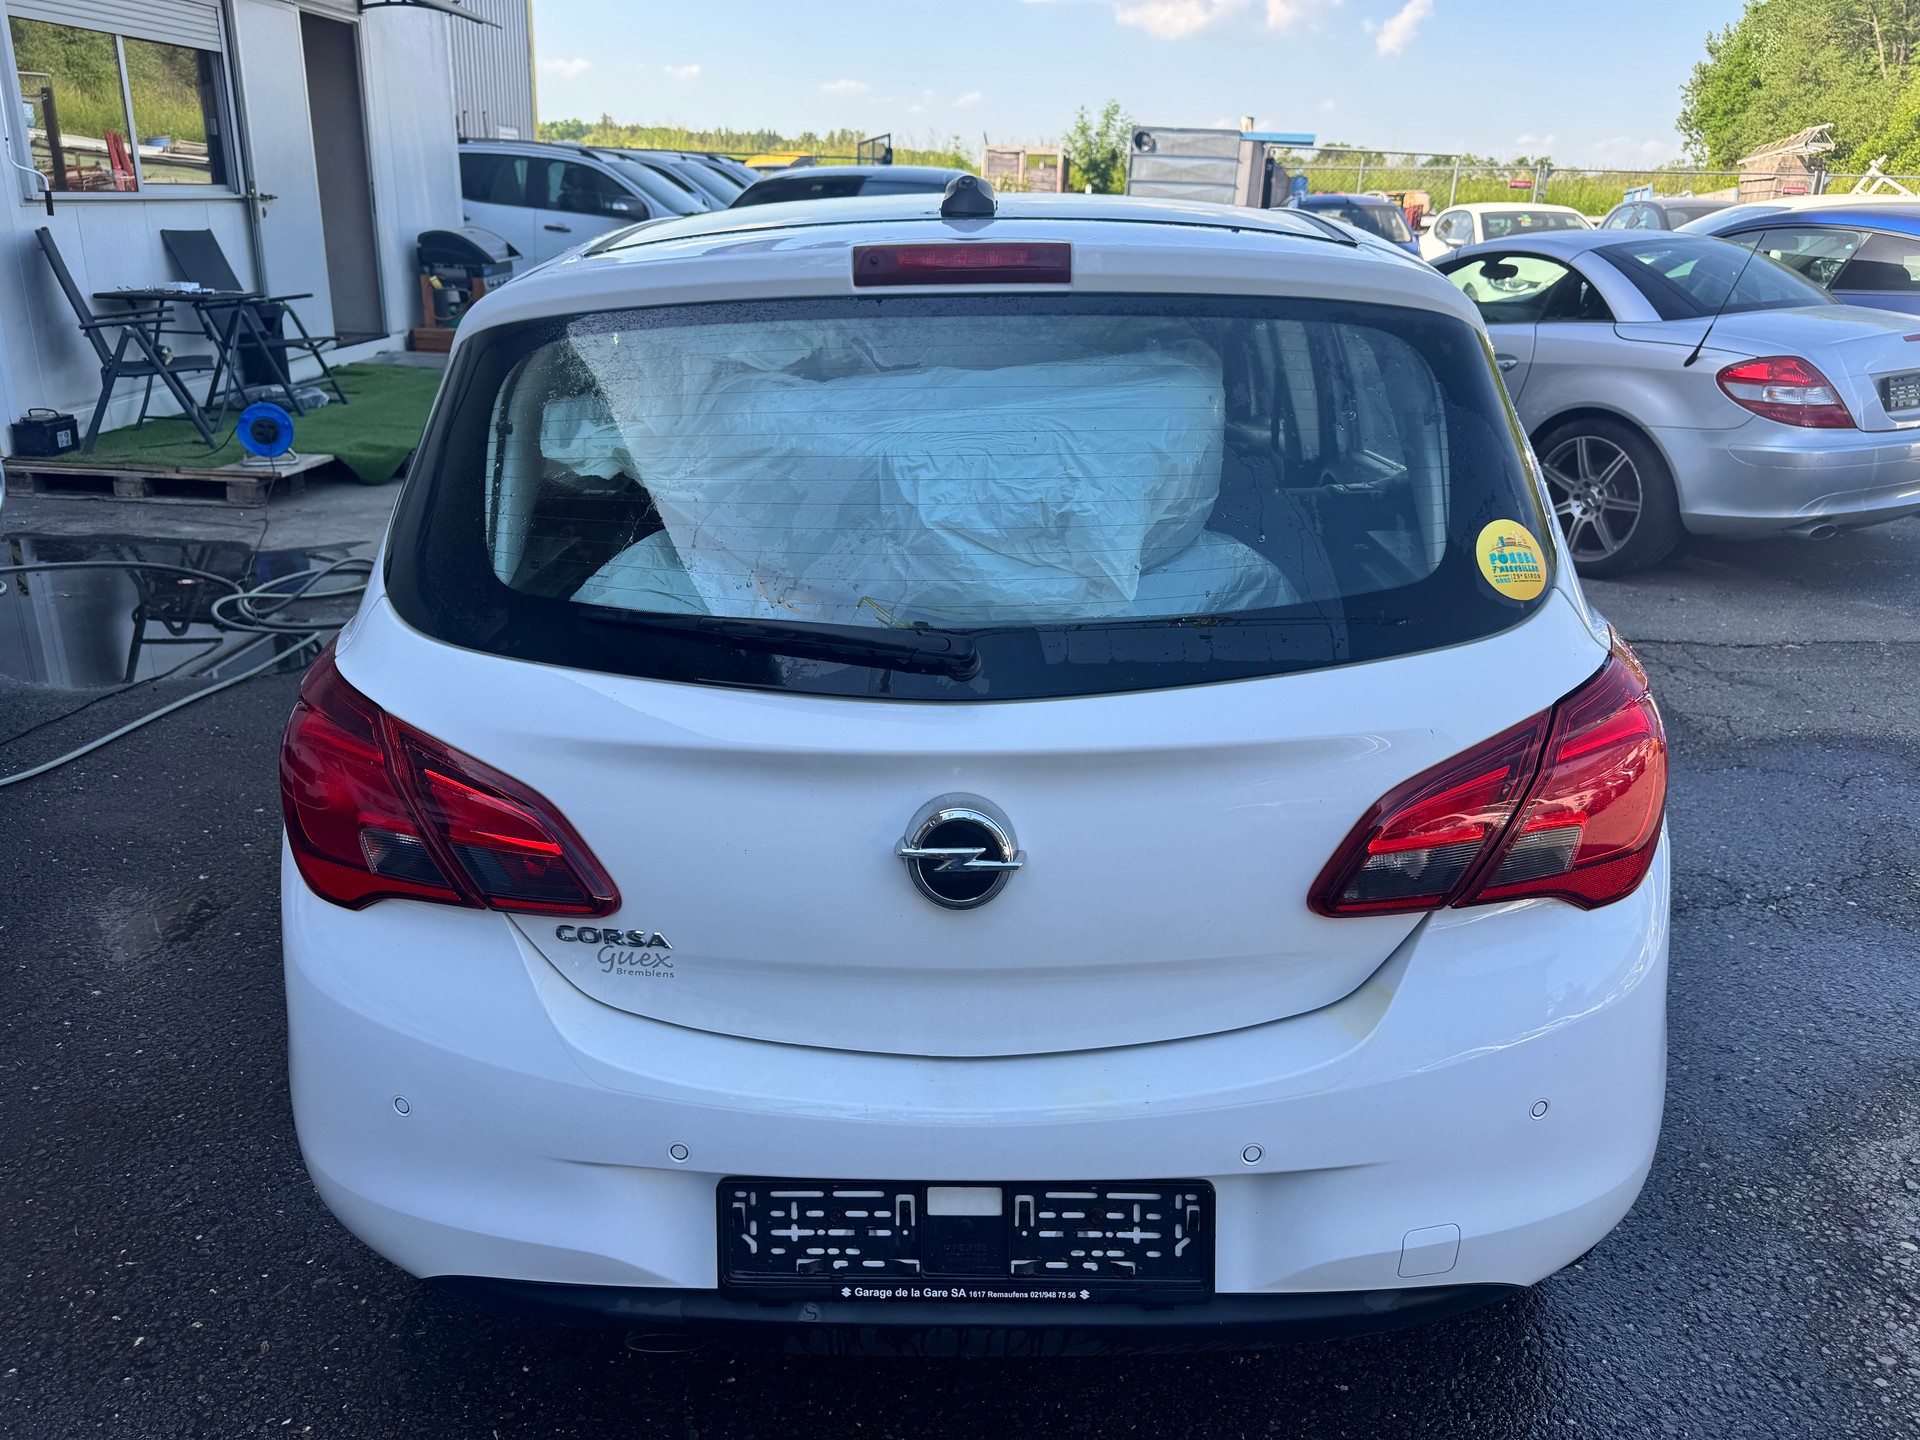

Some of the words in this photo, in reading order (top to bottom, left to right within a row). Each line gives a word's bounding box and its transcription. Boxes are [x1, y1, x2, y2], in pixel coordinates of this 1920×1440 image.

[555, 924, 674, 950] CORSA
[597, 945, 674, 974] Guex
[616, 967, 675, 979] Bremblens
[854, 1287, 893, 1299] Garage
[895, 1288, 908, 1297] de
[911, 1288, 920, 1297] la
[923, 1288, 948, 1298] Gare
[951, 1288, 967, 1298] SA
[969, 1290, 986, 1298] 1617
[987, 1290, 1029, 1298] Remaufens
[1029, 1291, 1057, 1299] 021/948
[1057, 1291, 1067, 1299] 75
[1067, 1291, 1077, 1299] 56
